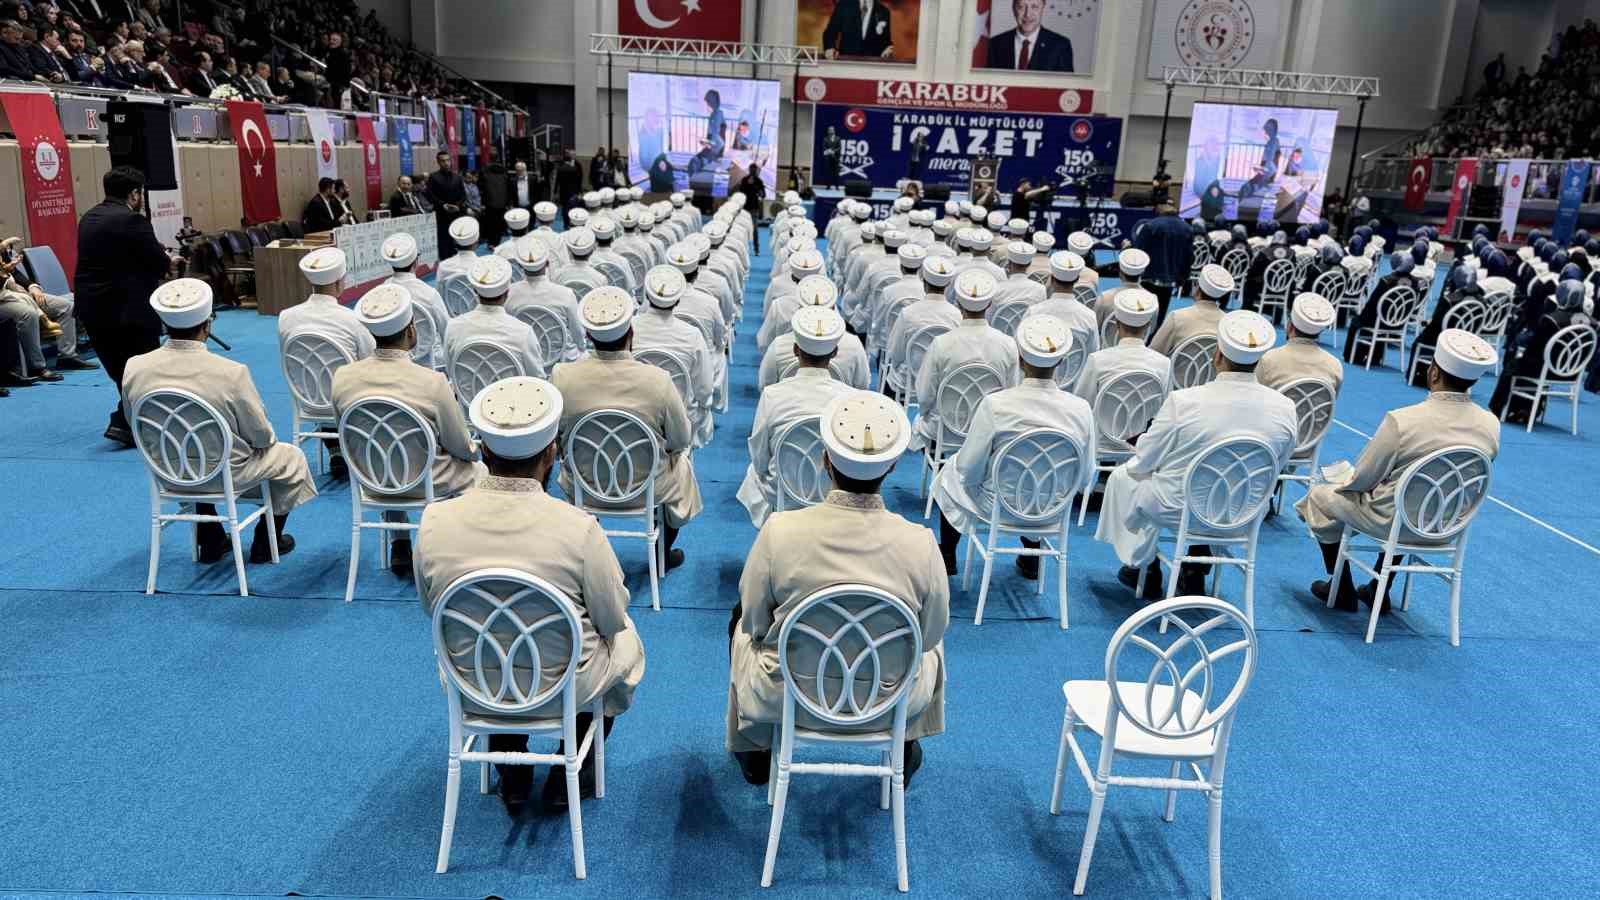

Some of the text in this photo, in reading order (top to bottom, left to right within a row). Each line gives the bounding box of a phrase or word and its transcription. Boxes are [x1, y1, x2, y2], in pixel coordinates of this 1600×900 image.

[878, 80, 1008, 103] KARABÜK
[85, 108, 98, 130] K
[893, 114, 1044, 130] KARABÜK İL MÜFTÜLÜĞÜ
[840, 139, 869, 156] 150
[1064, 148, 1094, 166] 150
[1088, 212, 1118, 228] 150
